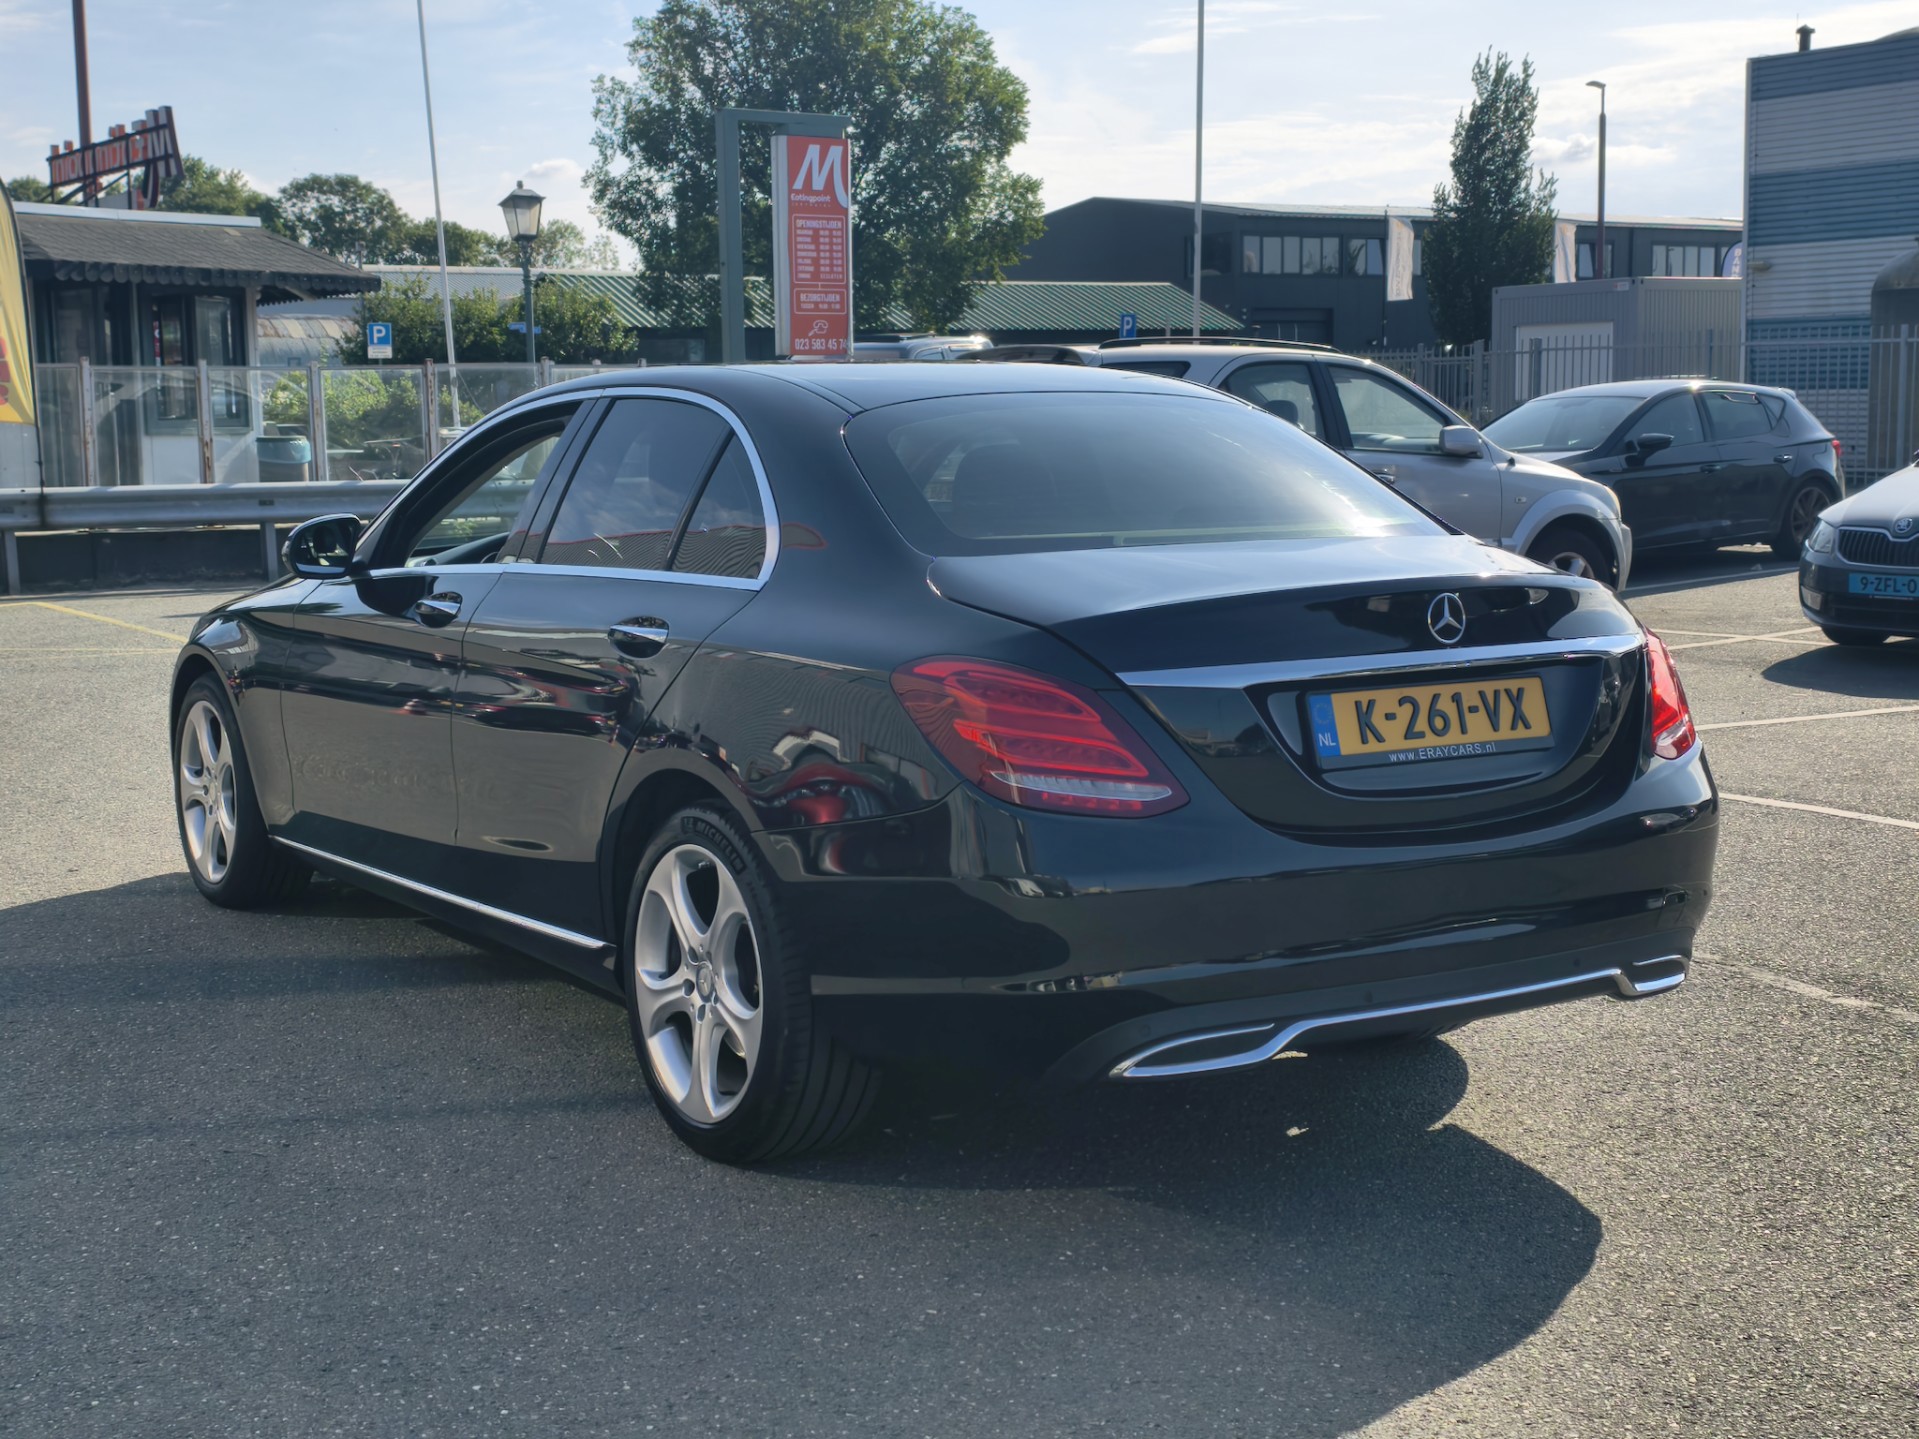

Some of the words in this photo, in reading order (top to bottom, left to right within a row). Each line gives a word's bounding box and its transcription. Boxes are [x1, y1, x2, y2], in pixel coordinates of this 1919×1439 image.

[791, 193, 831, 203] Eatingpoint
[373, 325, 386, 344] P
[1123, 316, 1133, 337] P
[795, 338, 809, 350] 023
[811, 338, 826, 350] 583
[827, 338, 838, 350] 45
[1355, 687, 1532, 745] K-261-VX
[1318, 732, 1336, 747] NL
[695, 821, 744, 871] MICHELIN
